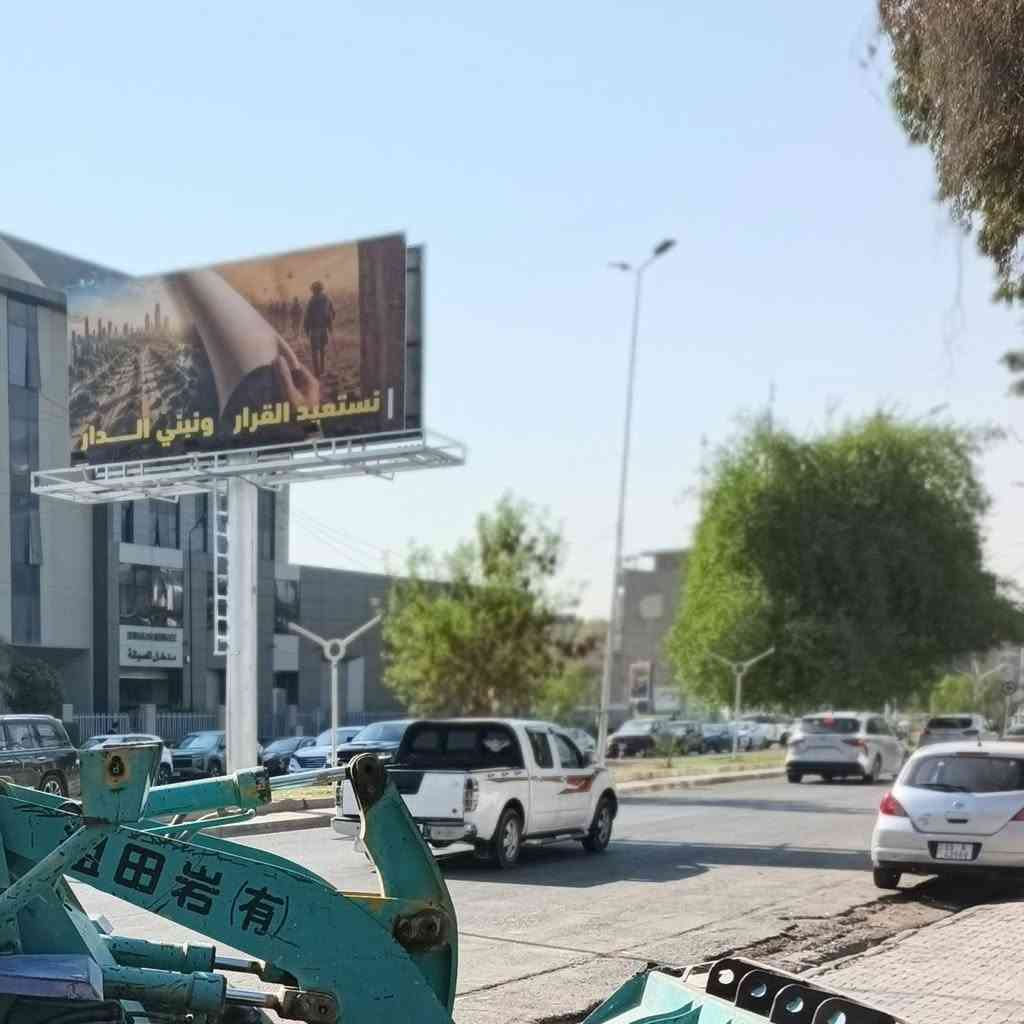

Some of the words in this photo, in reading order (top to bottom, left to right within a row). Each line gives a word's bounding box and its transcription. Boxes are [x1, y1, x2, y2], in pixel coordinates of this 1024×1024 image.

[233, 401, 289, 434] القرار
[296, 391, 380, 423] نستعيد
[156, 411, 214, 446] ونبني
